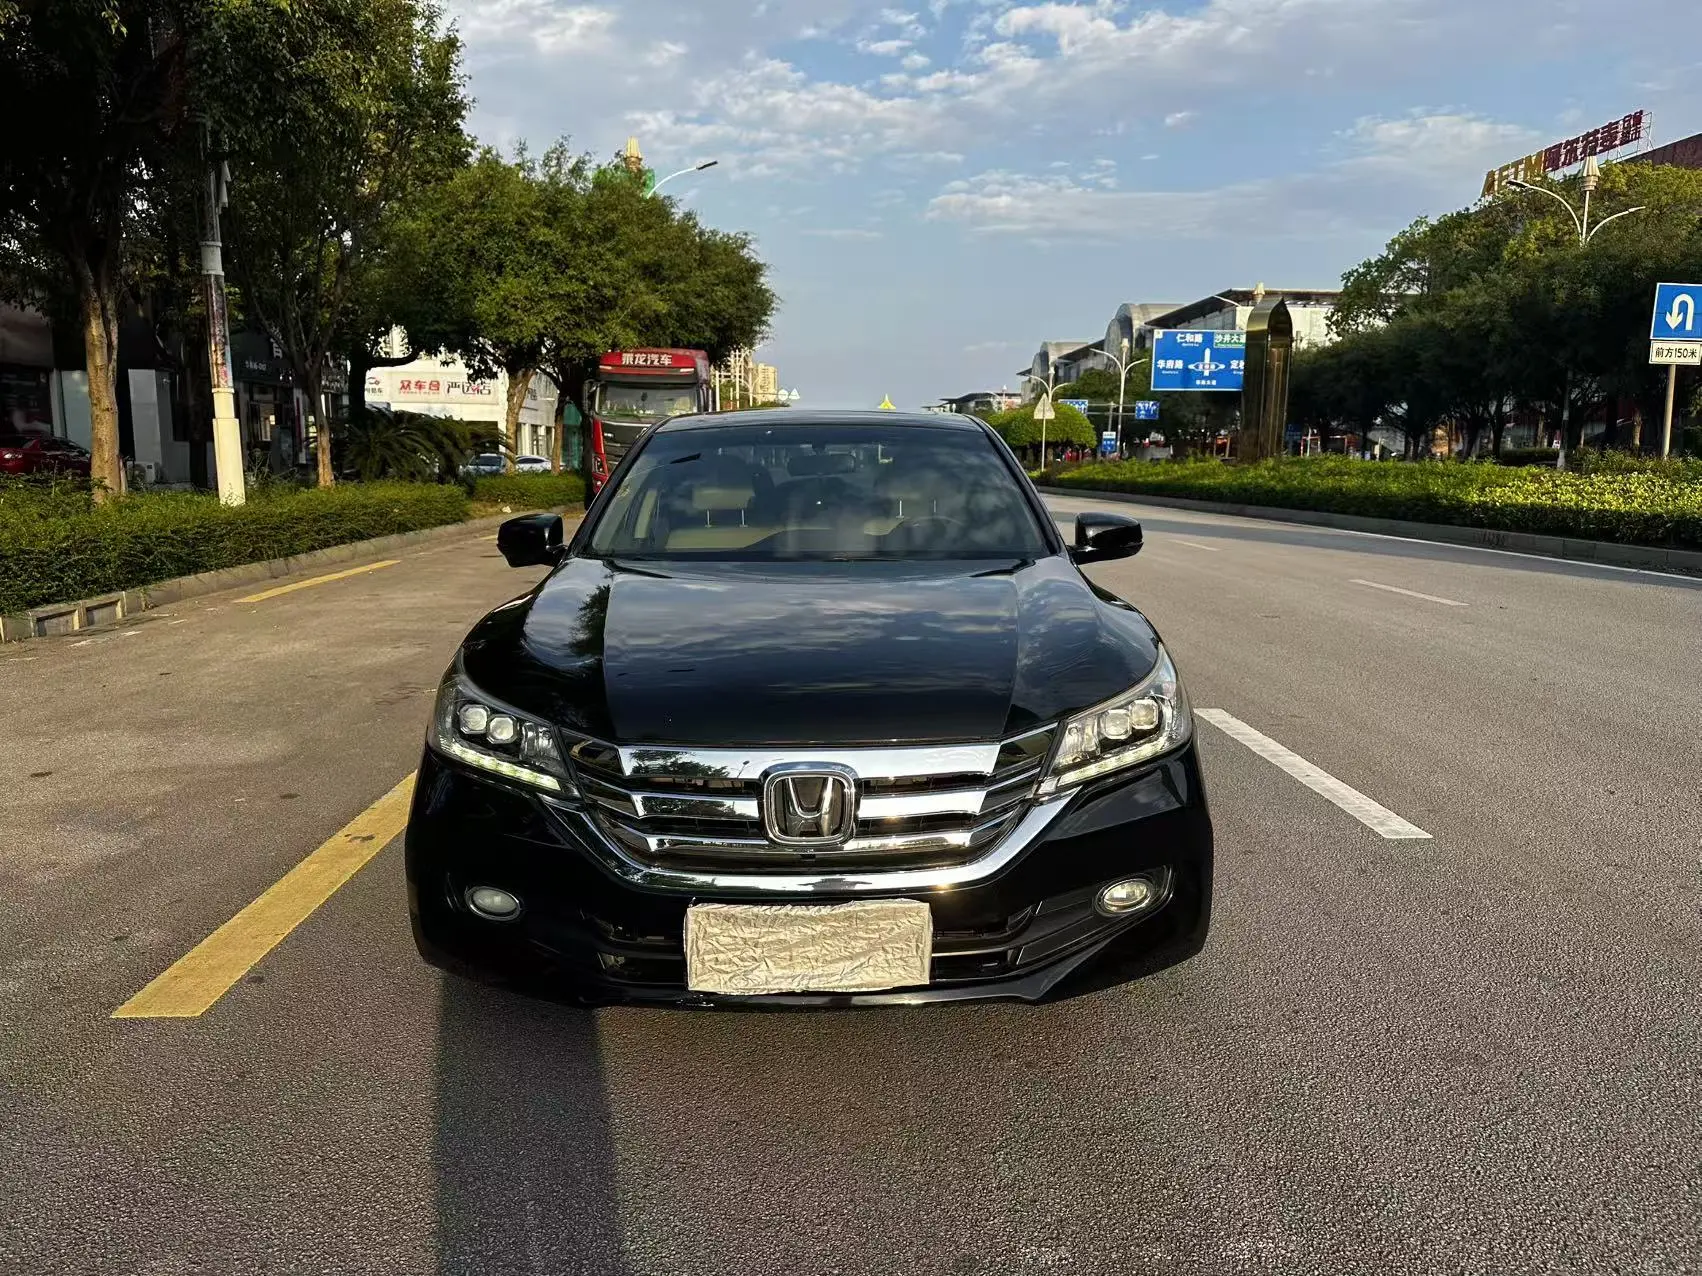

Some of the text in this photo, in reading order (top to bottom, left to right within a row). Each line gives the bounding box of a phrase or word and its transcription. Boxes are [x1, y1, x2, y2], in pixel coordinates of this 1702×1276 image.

[1655, 347, 1698, 359] 前方150米
[622, 353, 673, 366] 乘龙汽车
